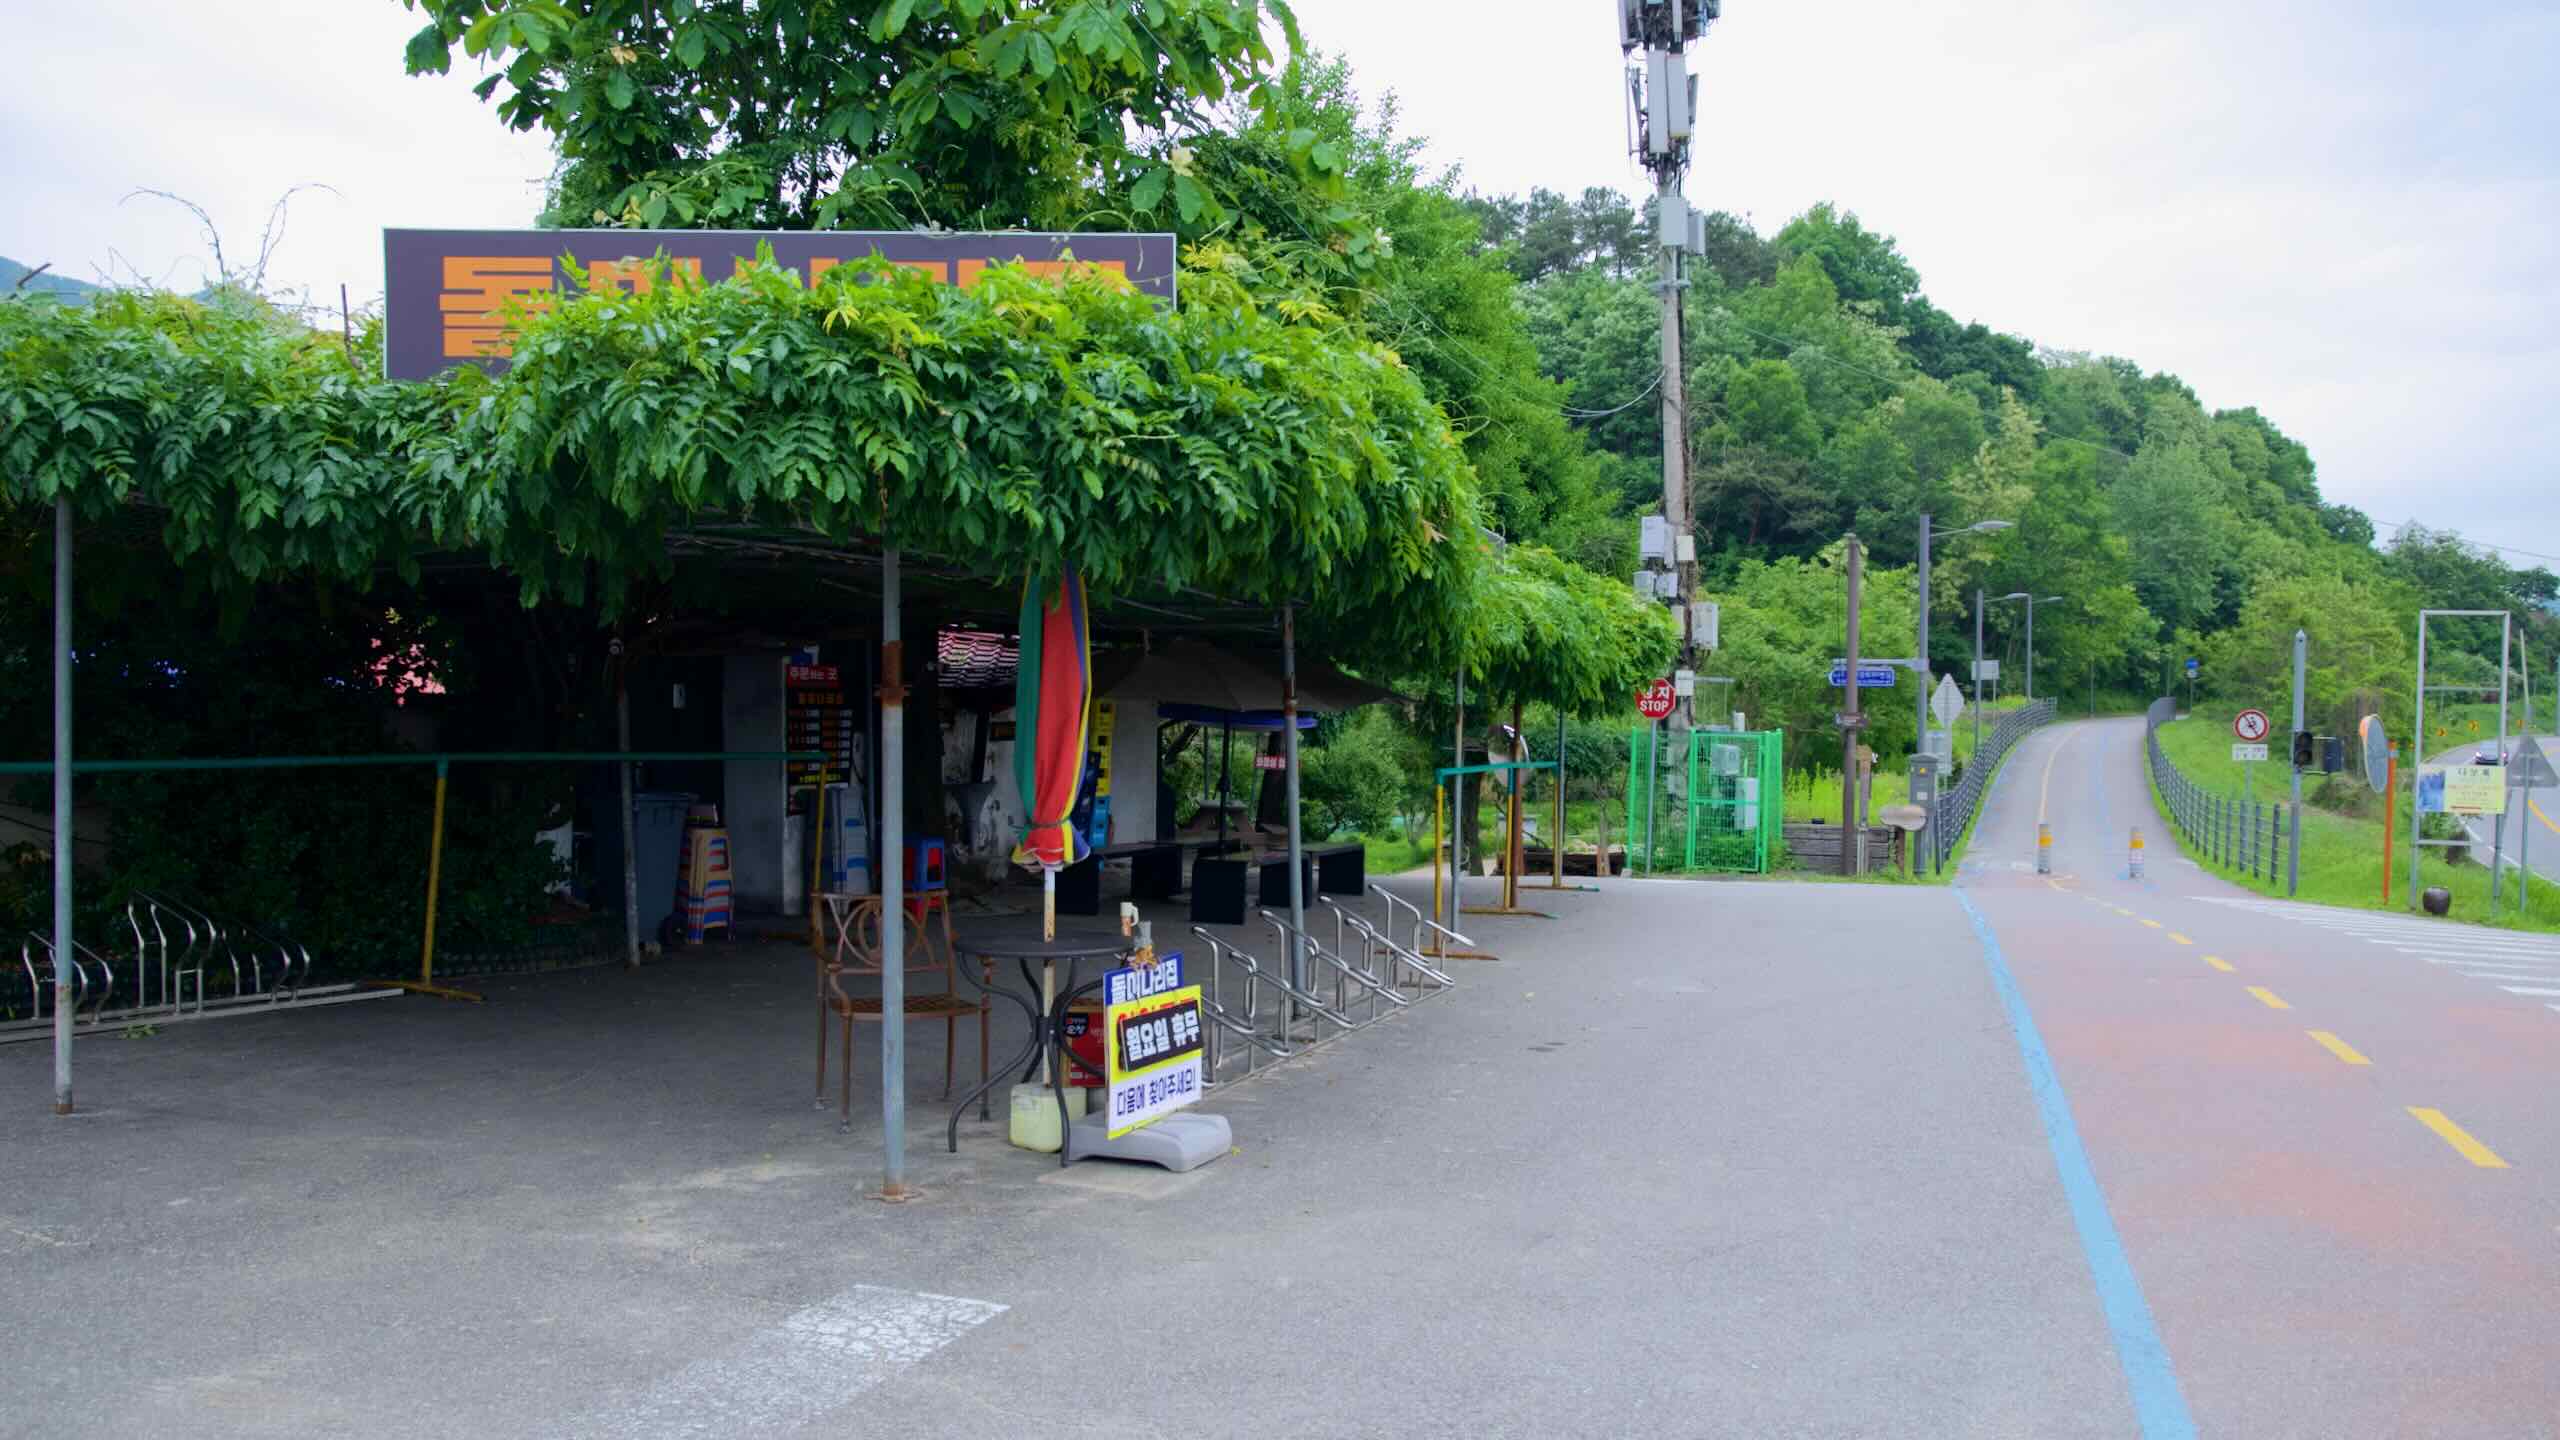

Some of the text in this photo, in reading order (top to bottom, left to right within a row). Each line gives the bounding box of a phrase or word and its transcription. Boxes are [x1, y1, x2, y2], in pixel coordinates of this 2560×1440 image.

[1640, 699, 1669, 713] STOP
[1126, 1018, 1171, 1062] 월요일
[1171, 1009, 1200, 1048] 휴무
[1117, 1083, 1145, 1116] 다음에
